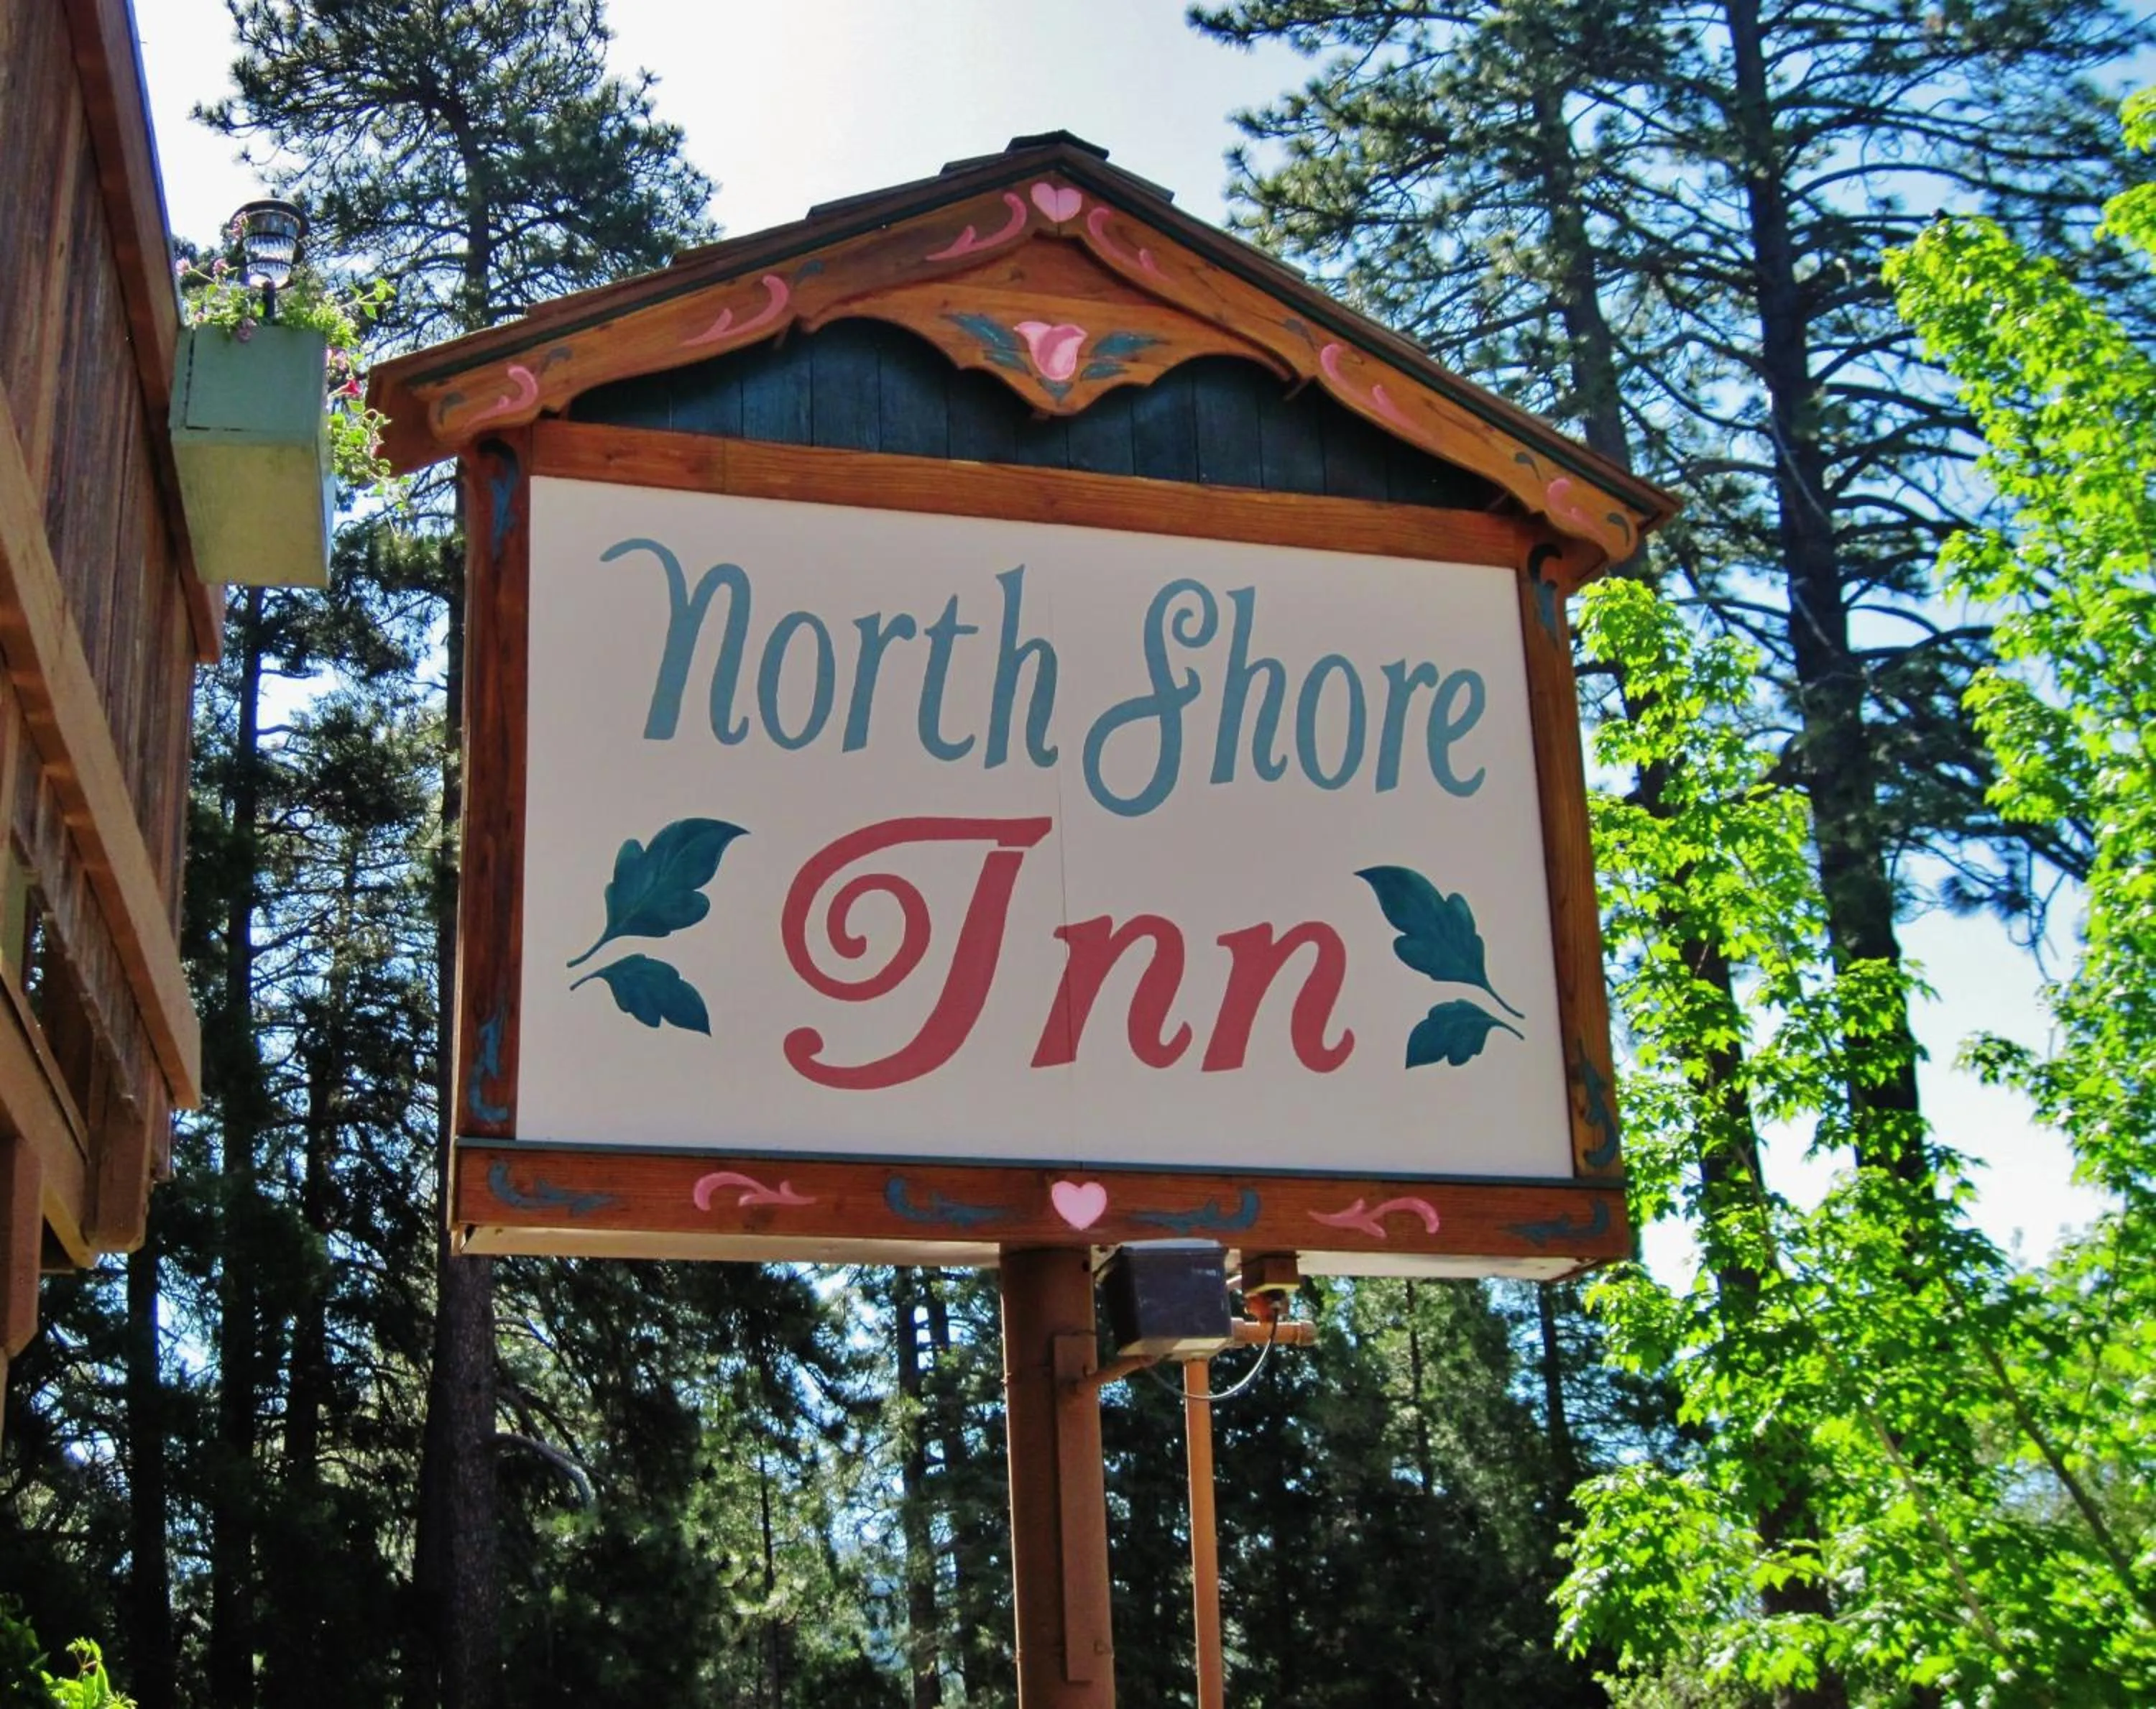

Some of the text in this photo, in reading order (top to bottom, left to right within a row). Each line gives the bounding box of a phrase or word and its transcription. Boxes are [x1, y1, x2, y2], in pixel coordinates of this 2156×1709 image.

[601, 537, 1487, 816] North Shore
[780, 816, 1356, 1091] Inn
